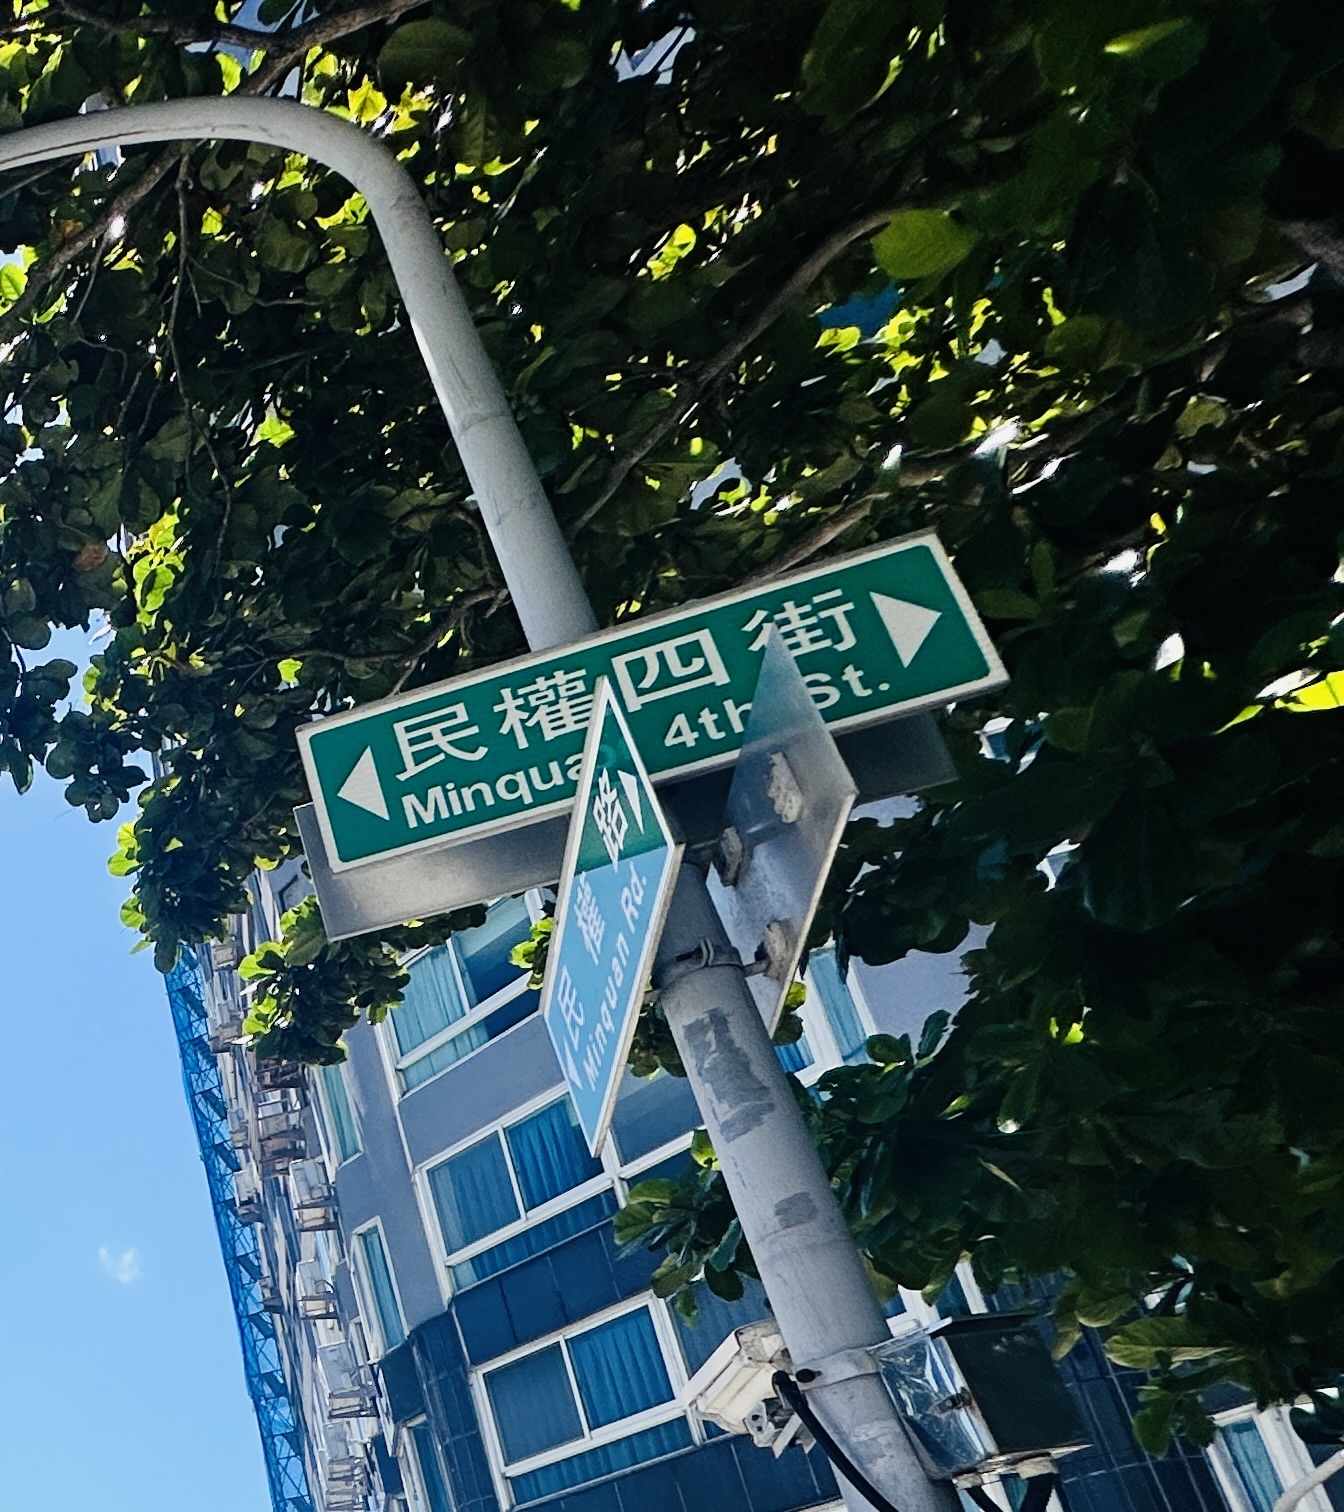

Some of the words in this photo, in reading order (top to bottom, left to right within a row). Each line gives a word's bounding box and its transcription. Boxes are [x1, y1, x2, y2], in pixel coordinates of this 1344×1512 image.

[395, 587, 855, 782] 民權四街
[401, 750, 582, 829] Minqua
[664, 699, 752, 748] 4th
[802, 663, 891, 711] St.
[558, 766, 630, 1052] 民權路
[582, 932, 631, 1092] Minquan
[620, 861, 648, 936] Rd.
